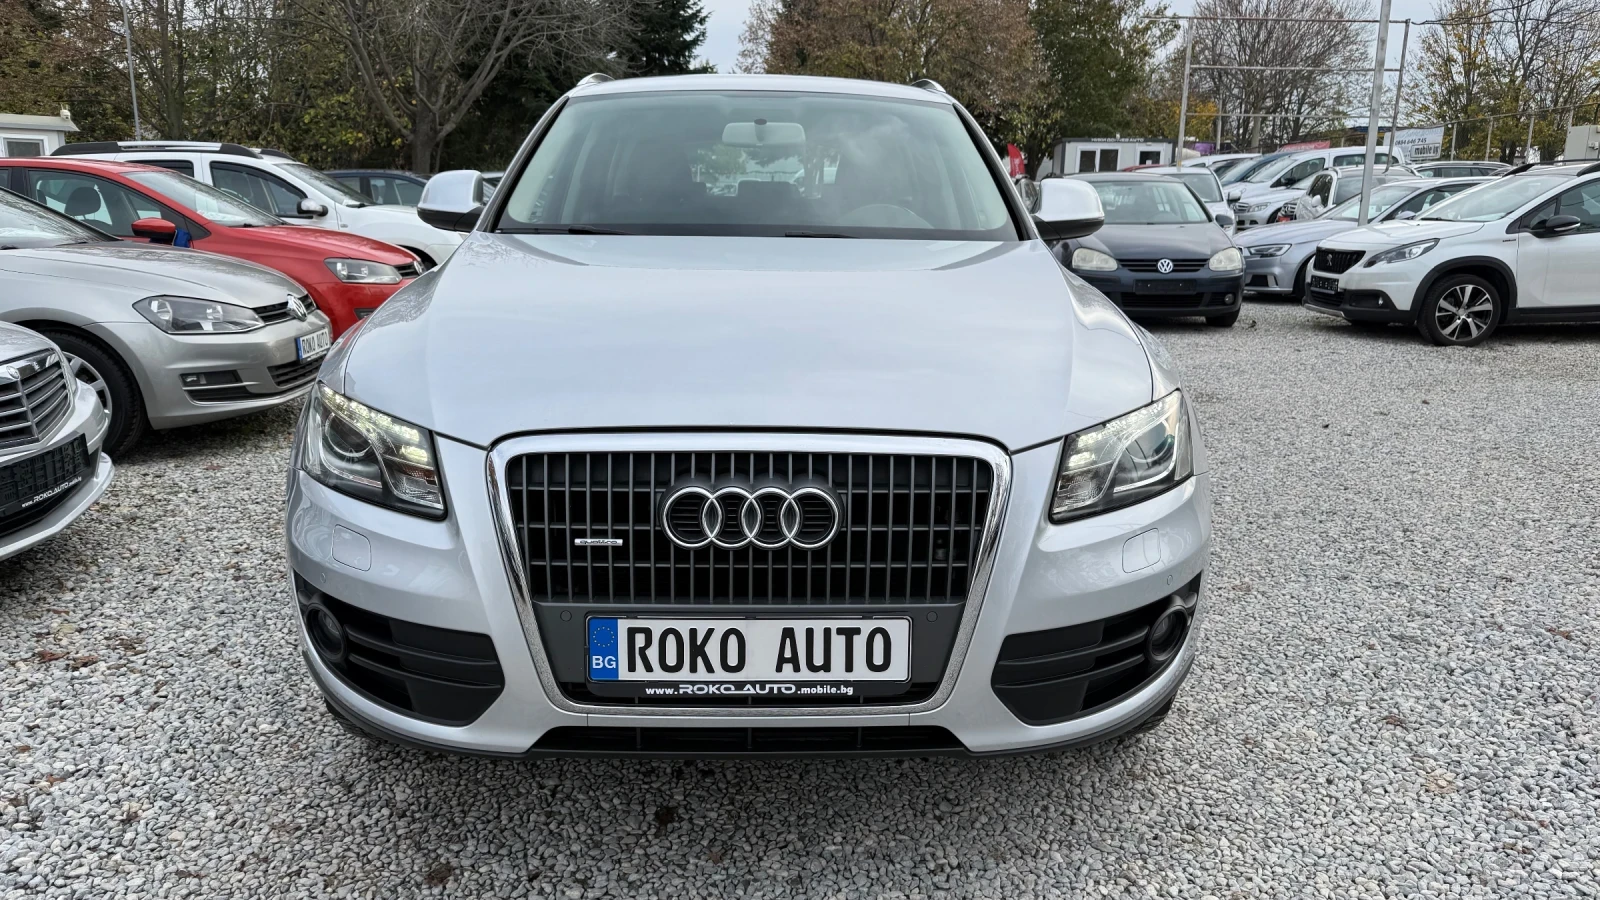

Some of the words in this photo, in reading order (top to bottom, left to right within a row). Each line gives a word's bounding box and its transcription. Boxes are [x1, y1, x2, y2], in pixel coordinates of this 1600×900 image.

[592, 655, 617, 669] BG
[627, 626, 747, 674] ROKO
[775, 626, 892, 674] AUTO
